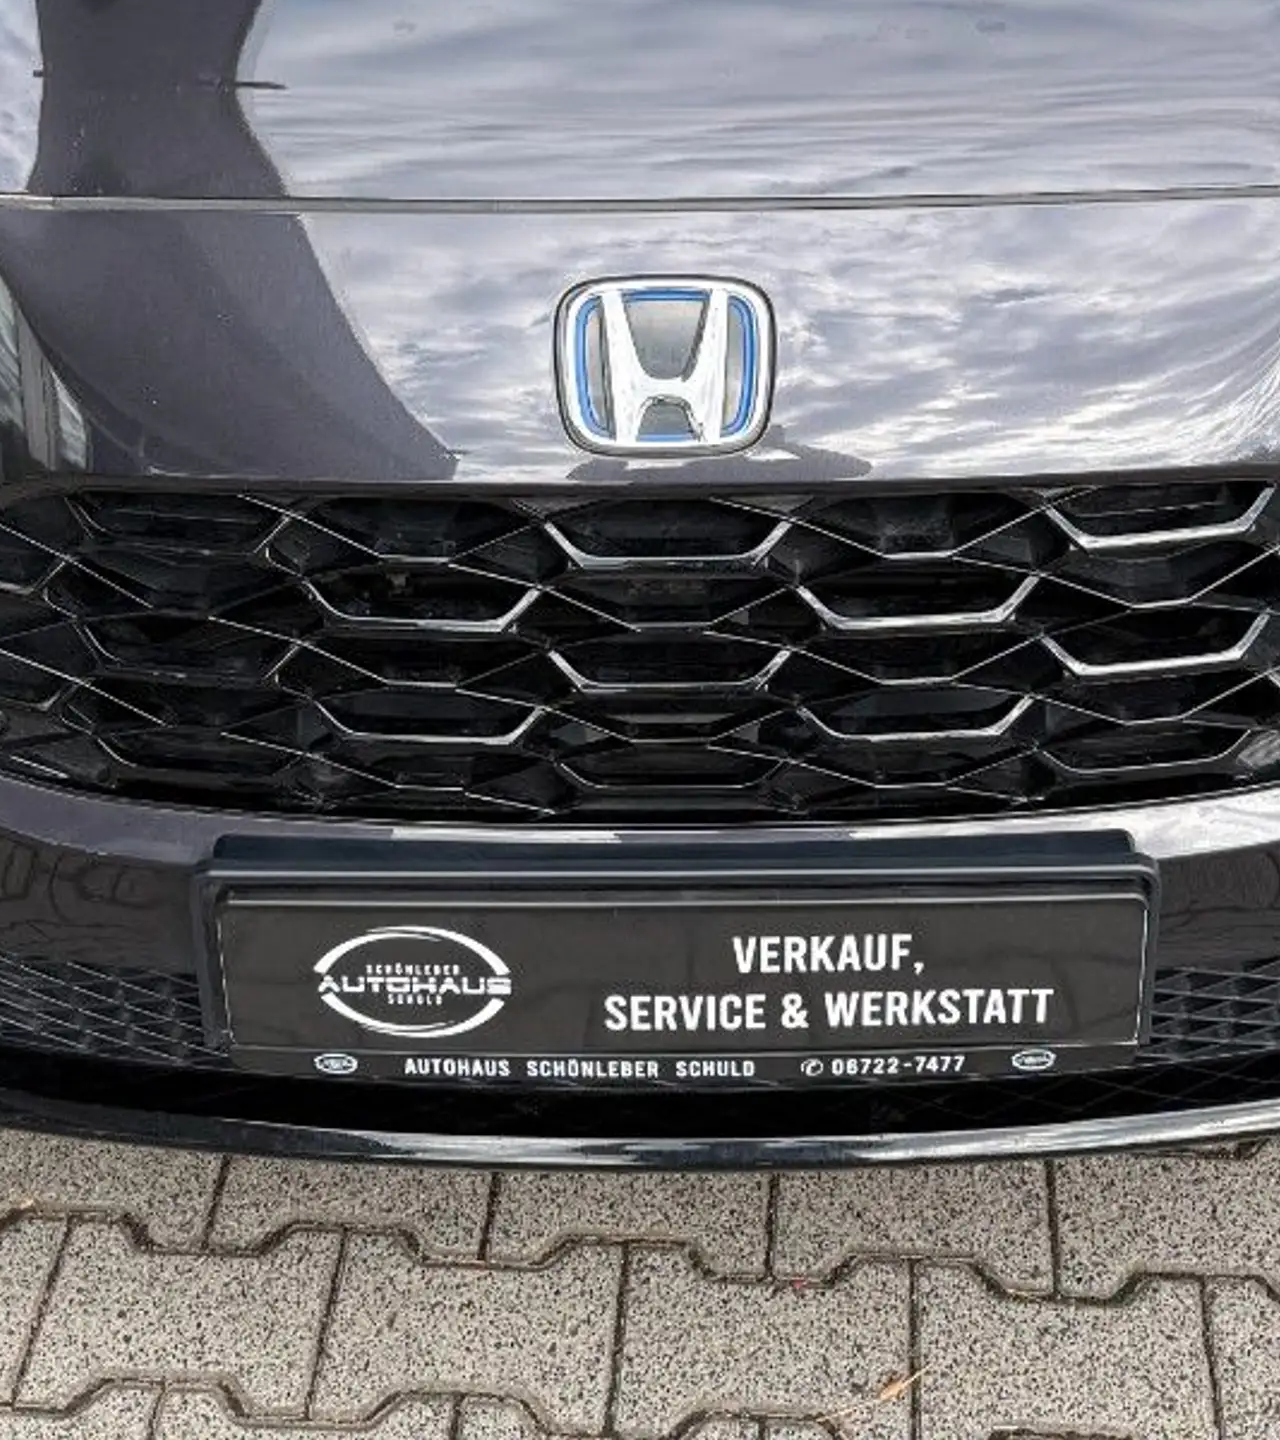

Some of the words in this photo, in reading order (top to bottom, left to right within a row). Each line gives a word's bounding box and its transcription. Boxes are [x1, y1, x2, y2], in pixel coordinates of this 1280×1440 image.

[731, 933, 924, 975] VERKAUF,
[318, 975, 512, 995] AUTOHAUS
[604, 994, 766, 1030] SERVICE
[781, 993, 809, 1028] &
[824, 988, 1054, 1027] WERKSTATT
[404, 1058, 510, 1077] AUTOHAUS
[527, 1056, 659, 1078] SCHÖNLEBER
[675, 1061, 755, 1077] SCHULD
[831, 1055, 965, 1075] 06722-7477
